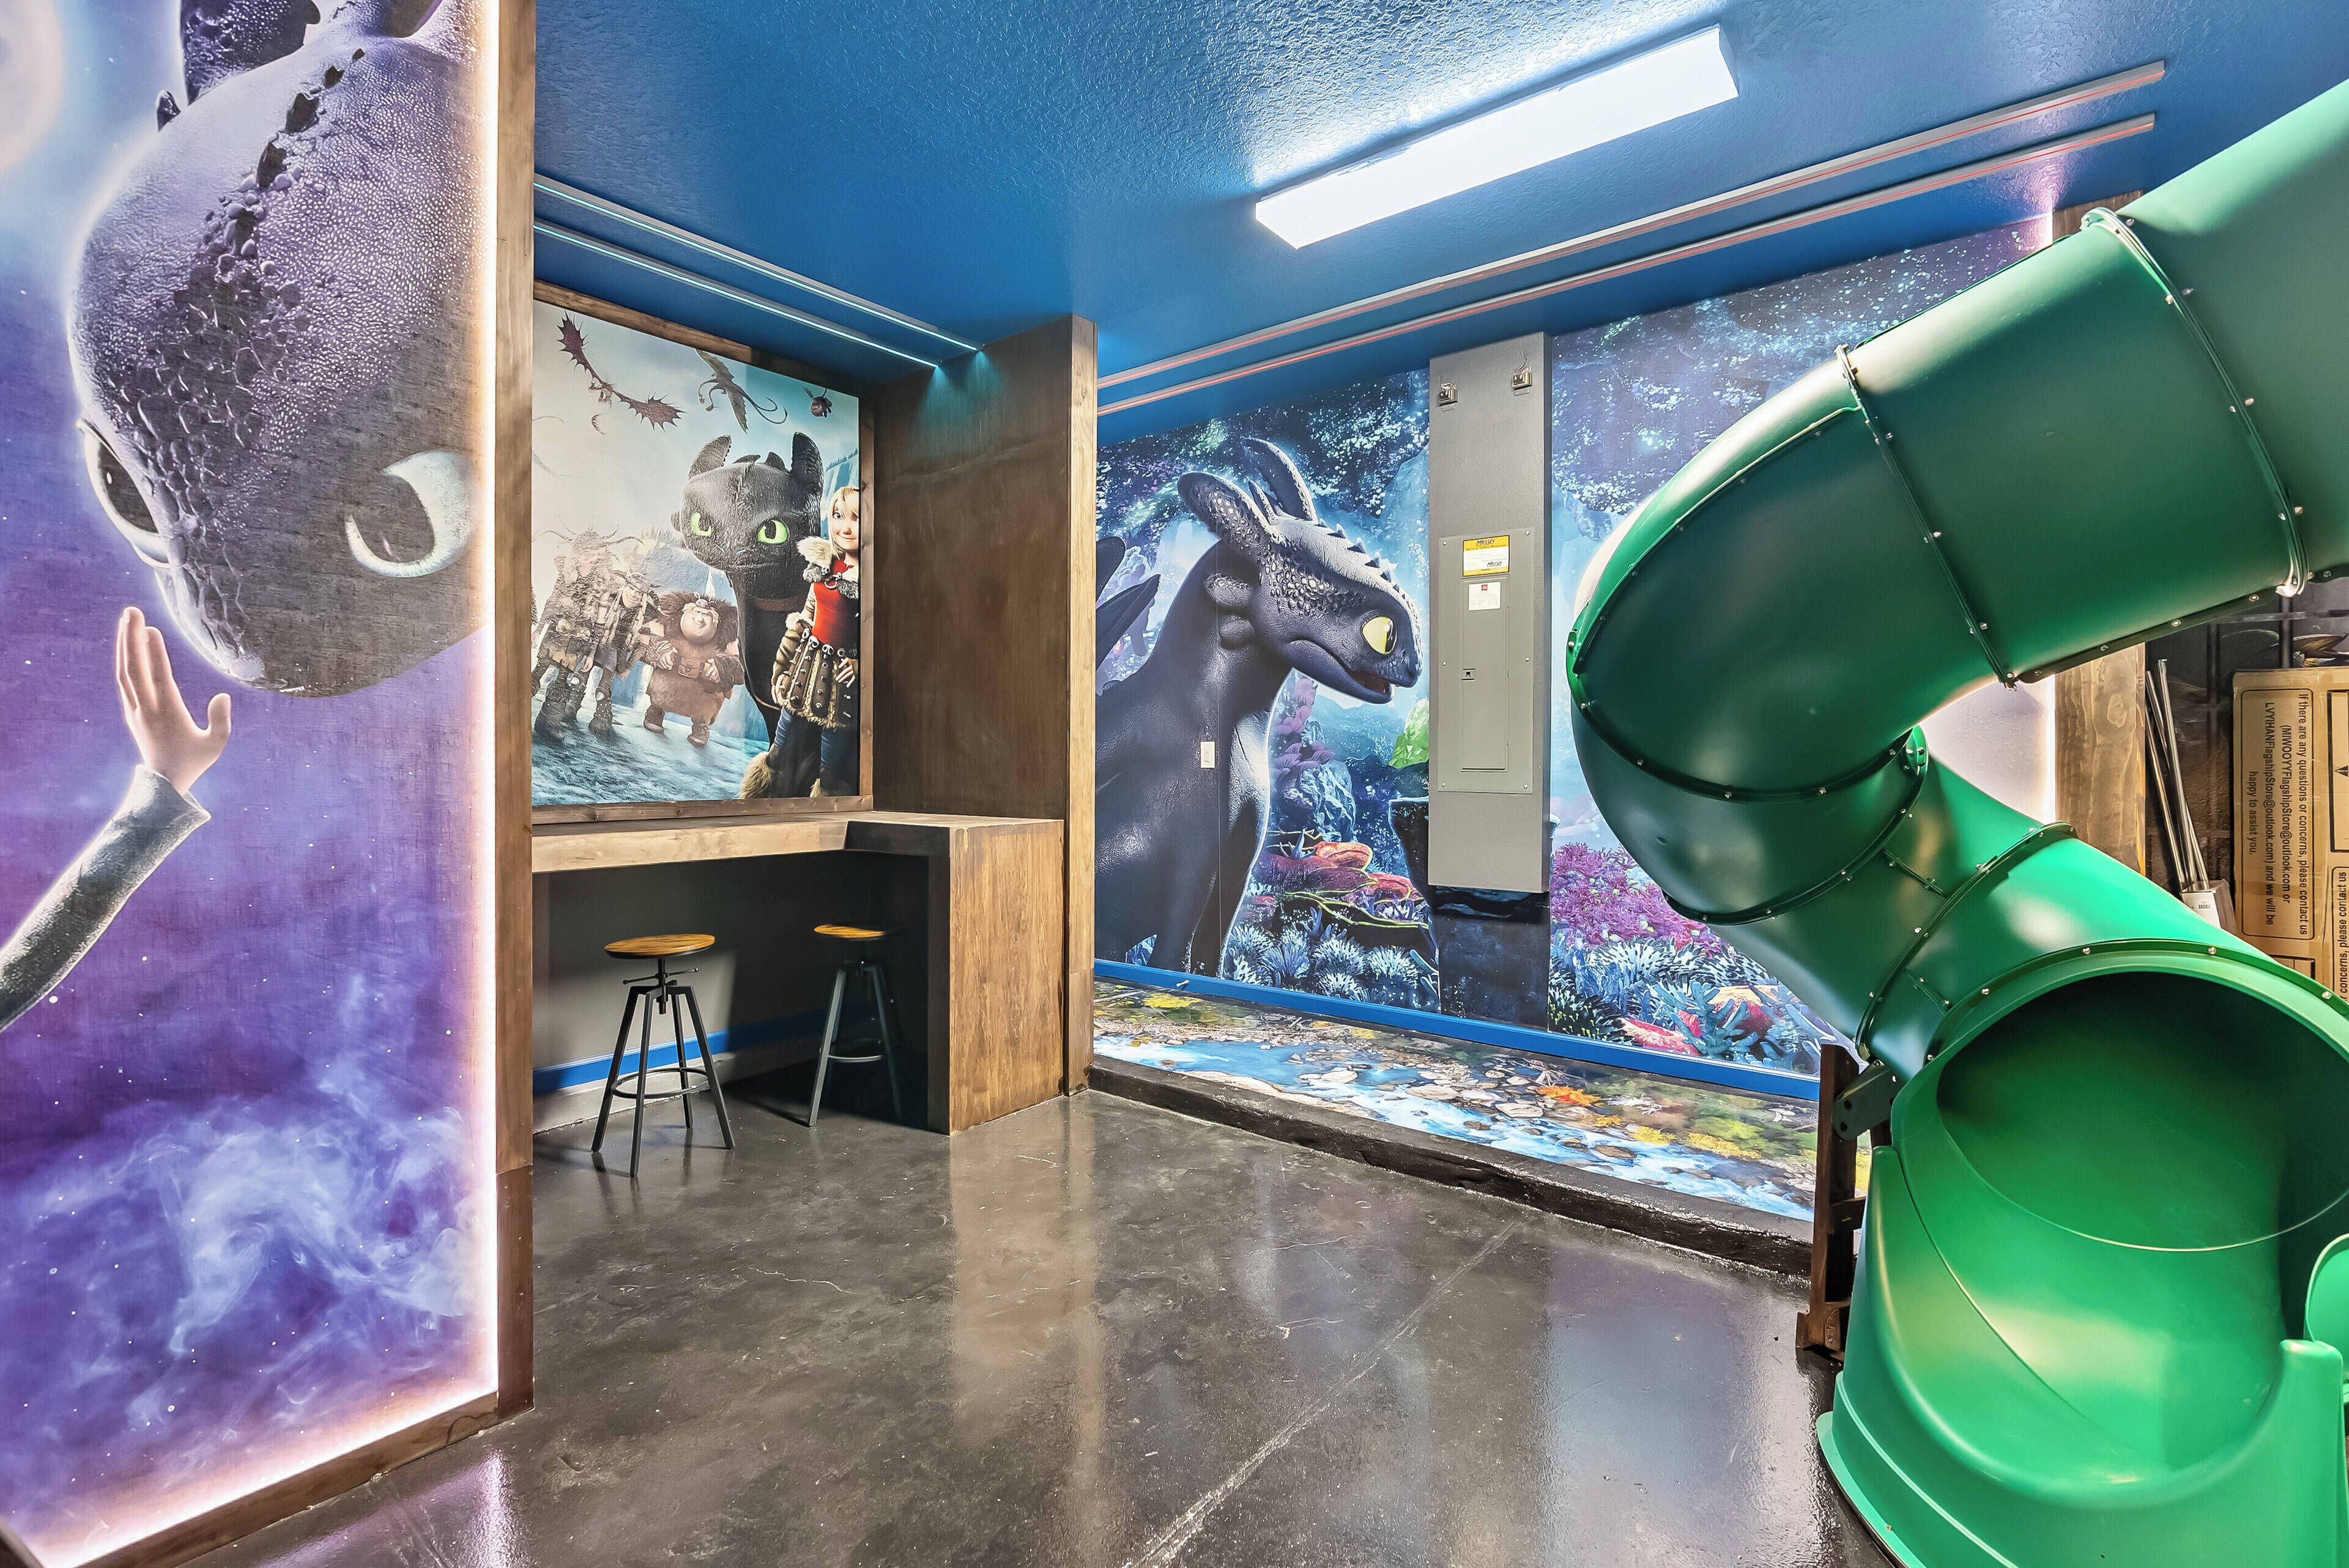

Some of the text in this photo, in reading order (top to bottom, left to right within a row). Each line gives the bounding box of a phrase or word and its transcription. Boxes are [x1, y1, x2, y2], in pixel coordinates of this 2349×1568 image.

[2298, 702, 2308, 723] there
[2296, 742, 2307, 757] any
[2246, 771, 2258, 797] happy
[2297, 760, 2309, 801] questions
[2249, 810, 2258, 835] assist
[2247, 837, 2257, 854] you.
[2298, 816, 2307, 857] concerns,
[2266, 866, 2276, 881] and
[2297, 860, 2309, 887] please
[2338, 872, 2346, 882] us
[2266, 884, 2274, 895] we
[2282, 895, 2290, 903] or
[2266, 898, 2276, 912] will
[2299, 890, 2309, 922] contact
[2266, 915, 2276, 925] be
[2299, 925, 2307, 934] us
[2337, 920, 2349, 948] please
[2339, 950, 2349, 993] concerns,
